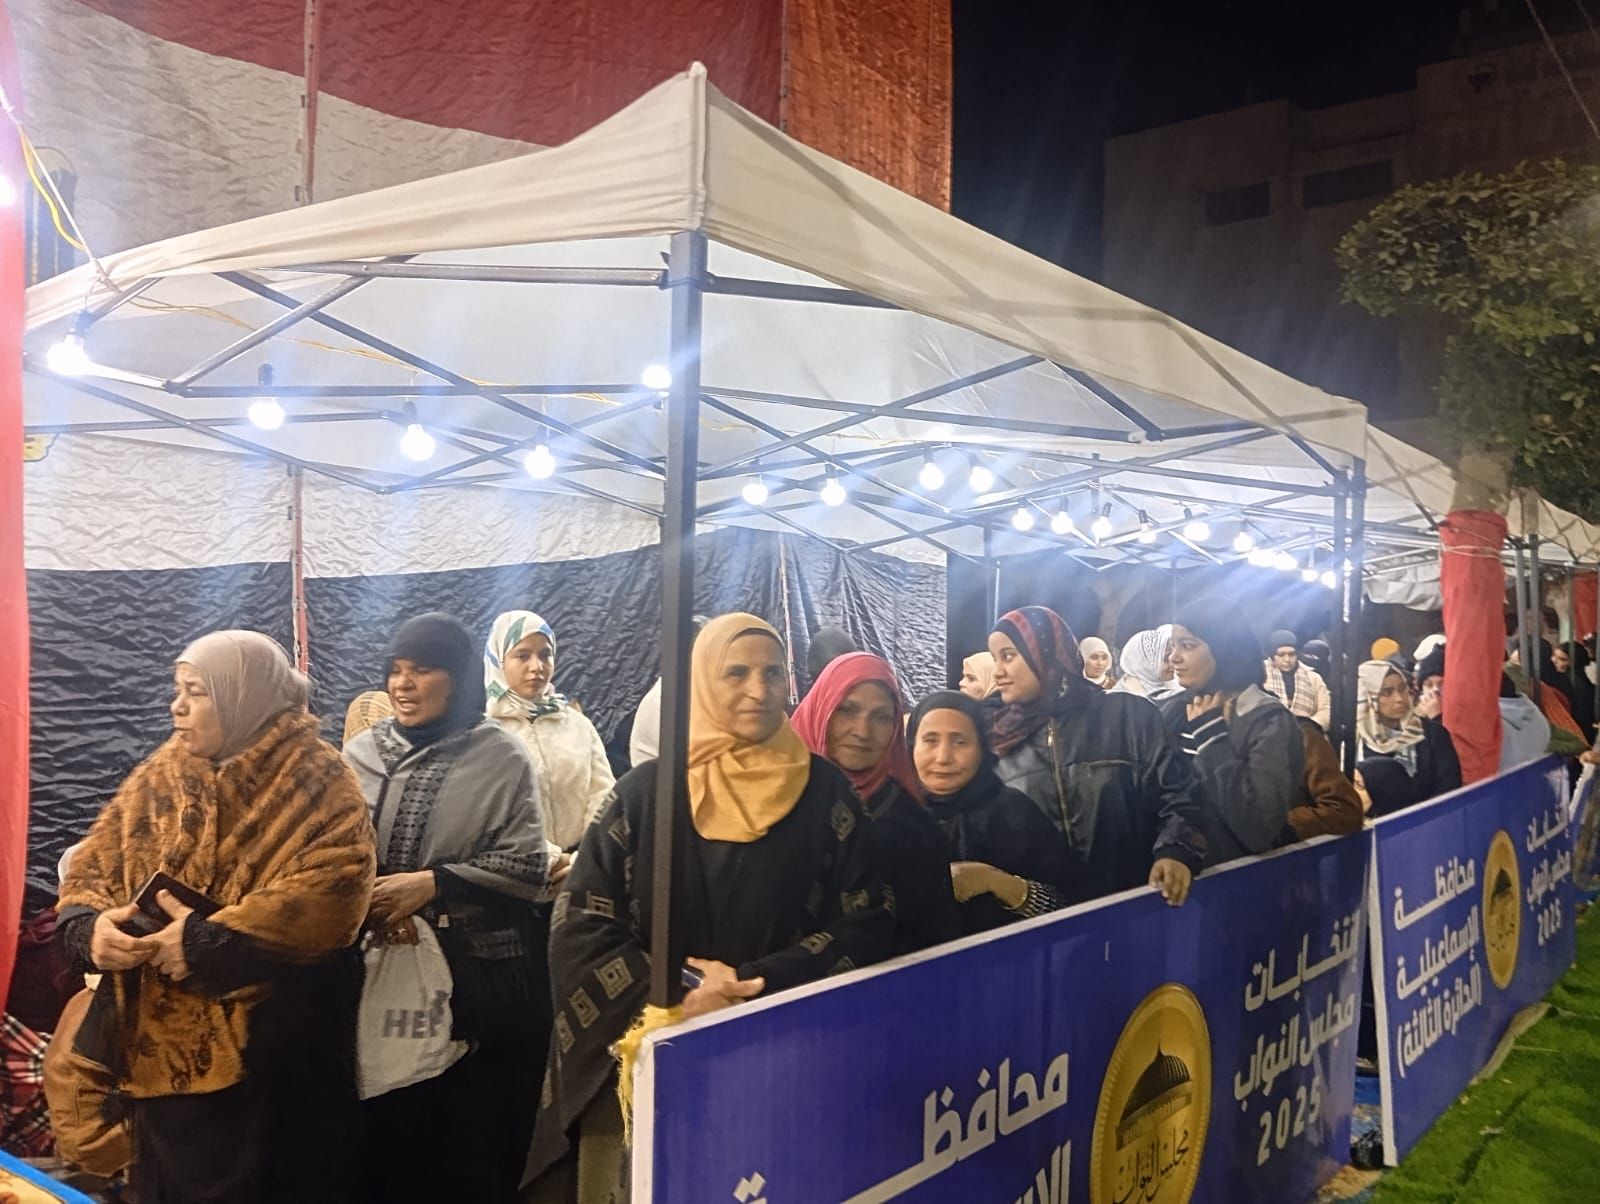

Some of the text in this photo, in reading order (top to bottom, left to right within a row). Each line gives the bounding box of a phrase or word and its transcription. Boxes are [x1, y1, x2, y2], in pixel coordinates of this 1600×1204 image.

[1394, 856, 1475, 931] محافظة
[1537, 898, 1561, 946] 2025
[1396, 904, 1479, 1000] الإسماعيلية
[1234, 993, 1356, 1112] مجلس النواب
[1257, 1074, 1321, 1167] 2025
